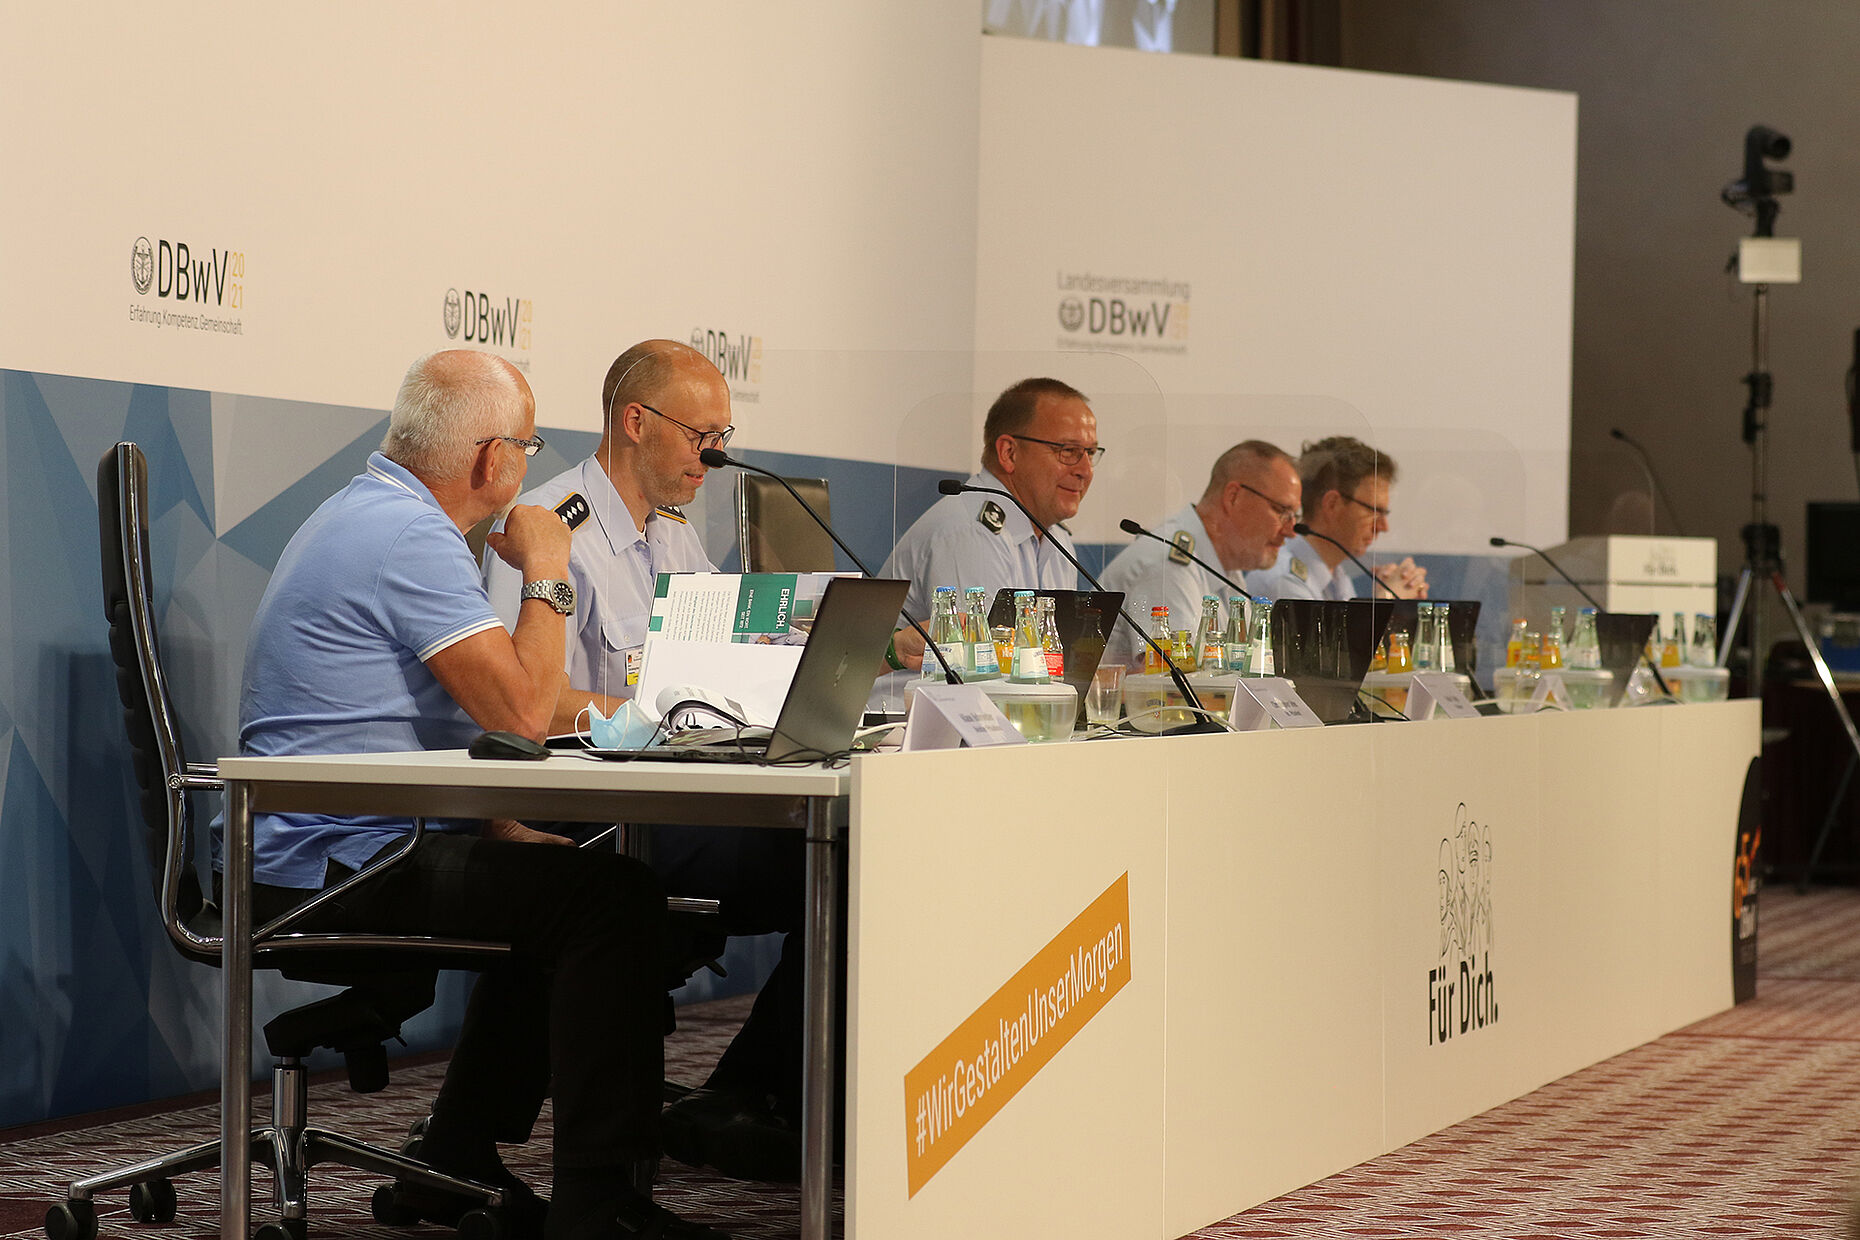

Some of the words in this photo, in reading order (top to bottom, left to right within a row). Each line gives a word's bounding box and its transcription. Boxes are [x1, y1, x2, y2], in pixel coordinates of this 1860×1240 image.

[158, 239, 228, 306] DBwV
[232, 251, 245, 278] 20
[1057, 270, 1191, 303] Landesversammlung
[231, 283, 243, 309] 21
[464, 290, 520, 348] DBwV
[1088, 298, 1171, 337] DBwV
[706, 329, 752, 382] DBwV
[775, 588, 791, 630] EHRLICH.
[1428, 965, 1455, 1047] Für
[1459, 950, 1499, 1036] Dich.
[915, 922, 1123, 1158] #WirGestaltenUnserMorgen
